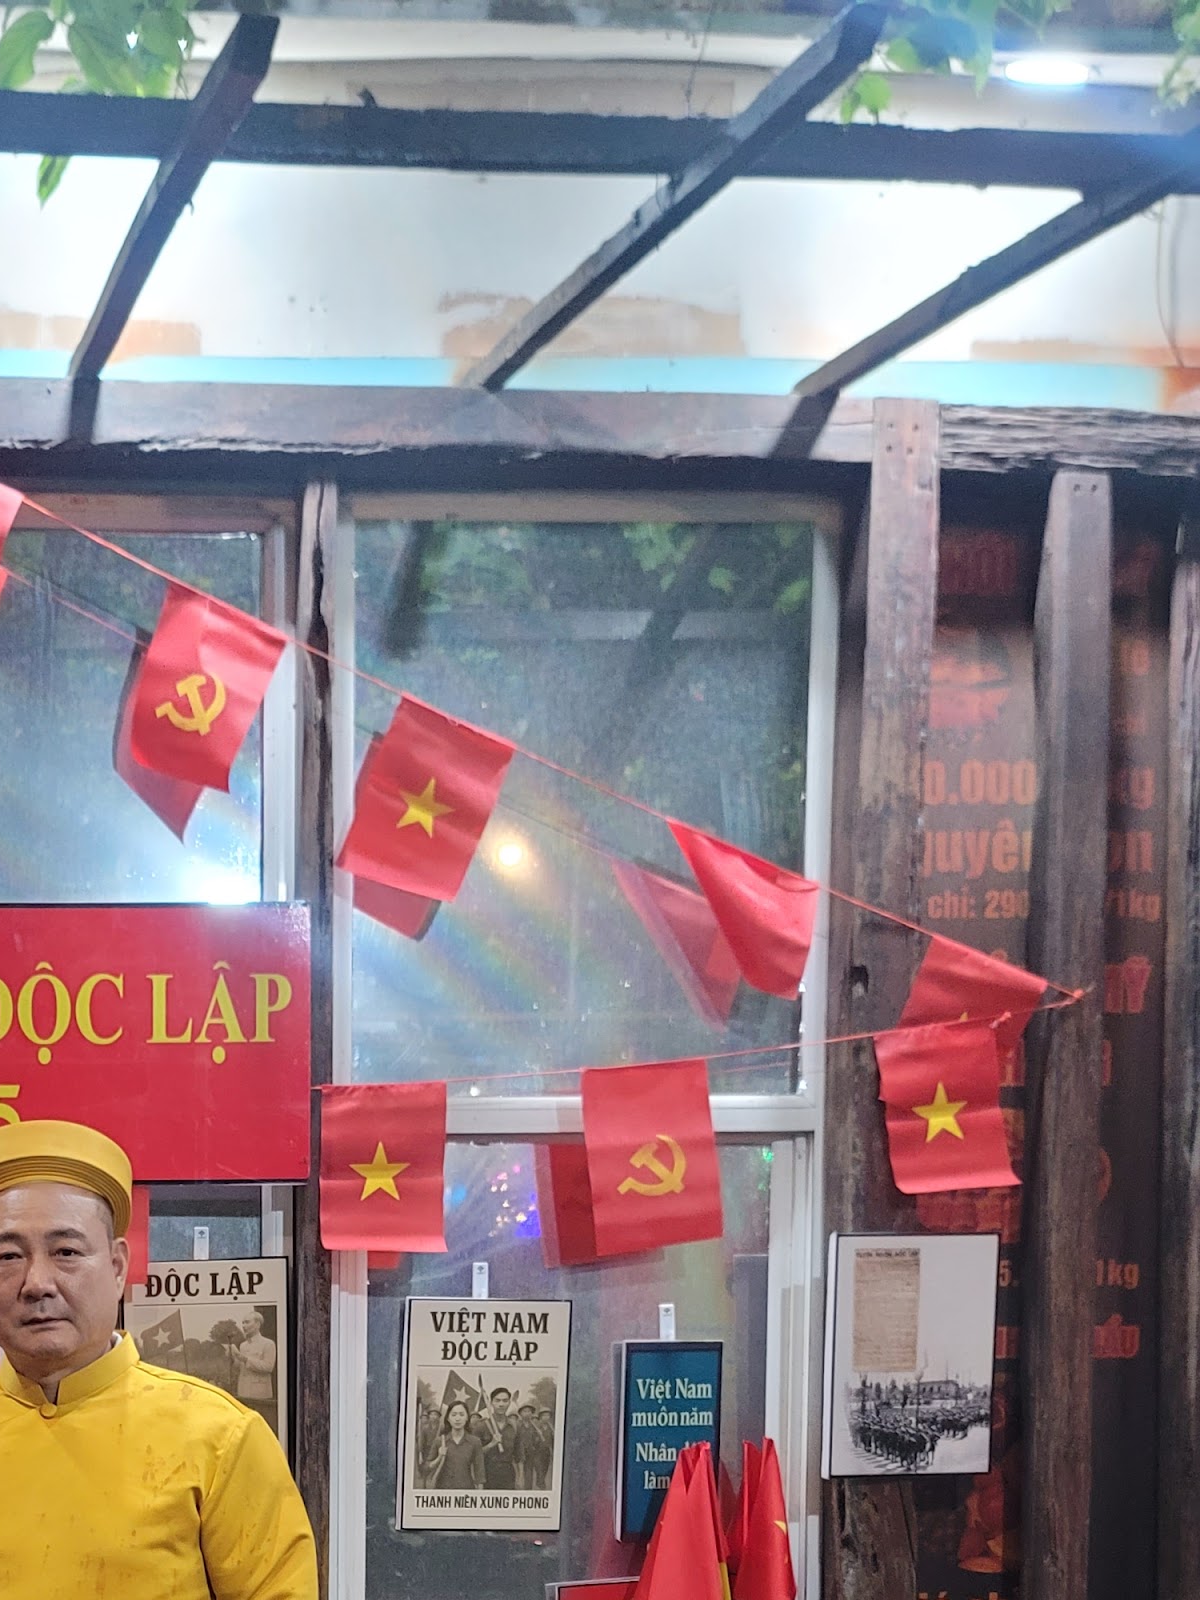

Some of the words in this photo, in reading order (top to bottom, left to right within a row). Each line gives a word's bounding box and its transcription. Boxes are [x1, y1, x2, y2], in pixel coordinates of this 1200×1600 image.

[146, 961, 293, 1064] LẬP
[145, 1268, 199, 1302] ĐỘC
[209, 1266, 264, 1301] LẬP
[431, 1307, 486, 1337] VIỆT
[492, 1312, 549, 1334] NAM
[441, 1339, 488, 1365] ĐỘC
[494, 1339, 538, 1366] LẬP
[636, 1379, 672, 1404] Việt
[674, 1378, 712, 1400] Nam
[631, 1406, 678, 1427] muôn
[680, 1407, 714, 1426] năm
[635, 1442, 678, 1463] Nhân
[644, 1470, 670, 1490] làm
[415, 1496, 451, 1509] THANH
[454, 1494, 477, 1509] NIÊN
[480, 1497, 510, 1509] XUNG
[512, 1497, 549, 1510] PHONG
